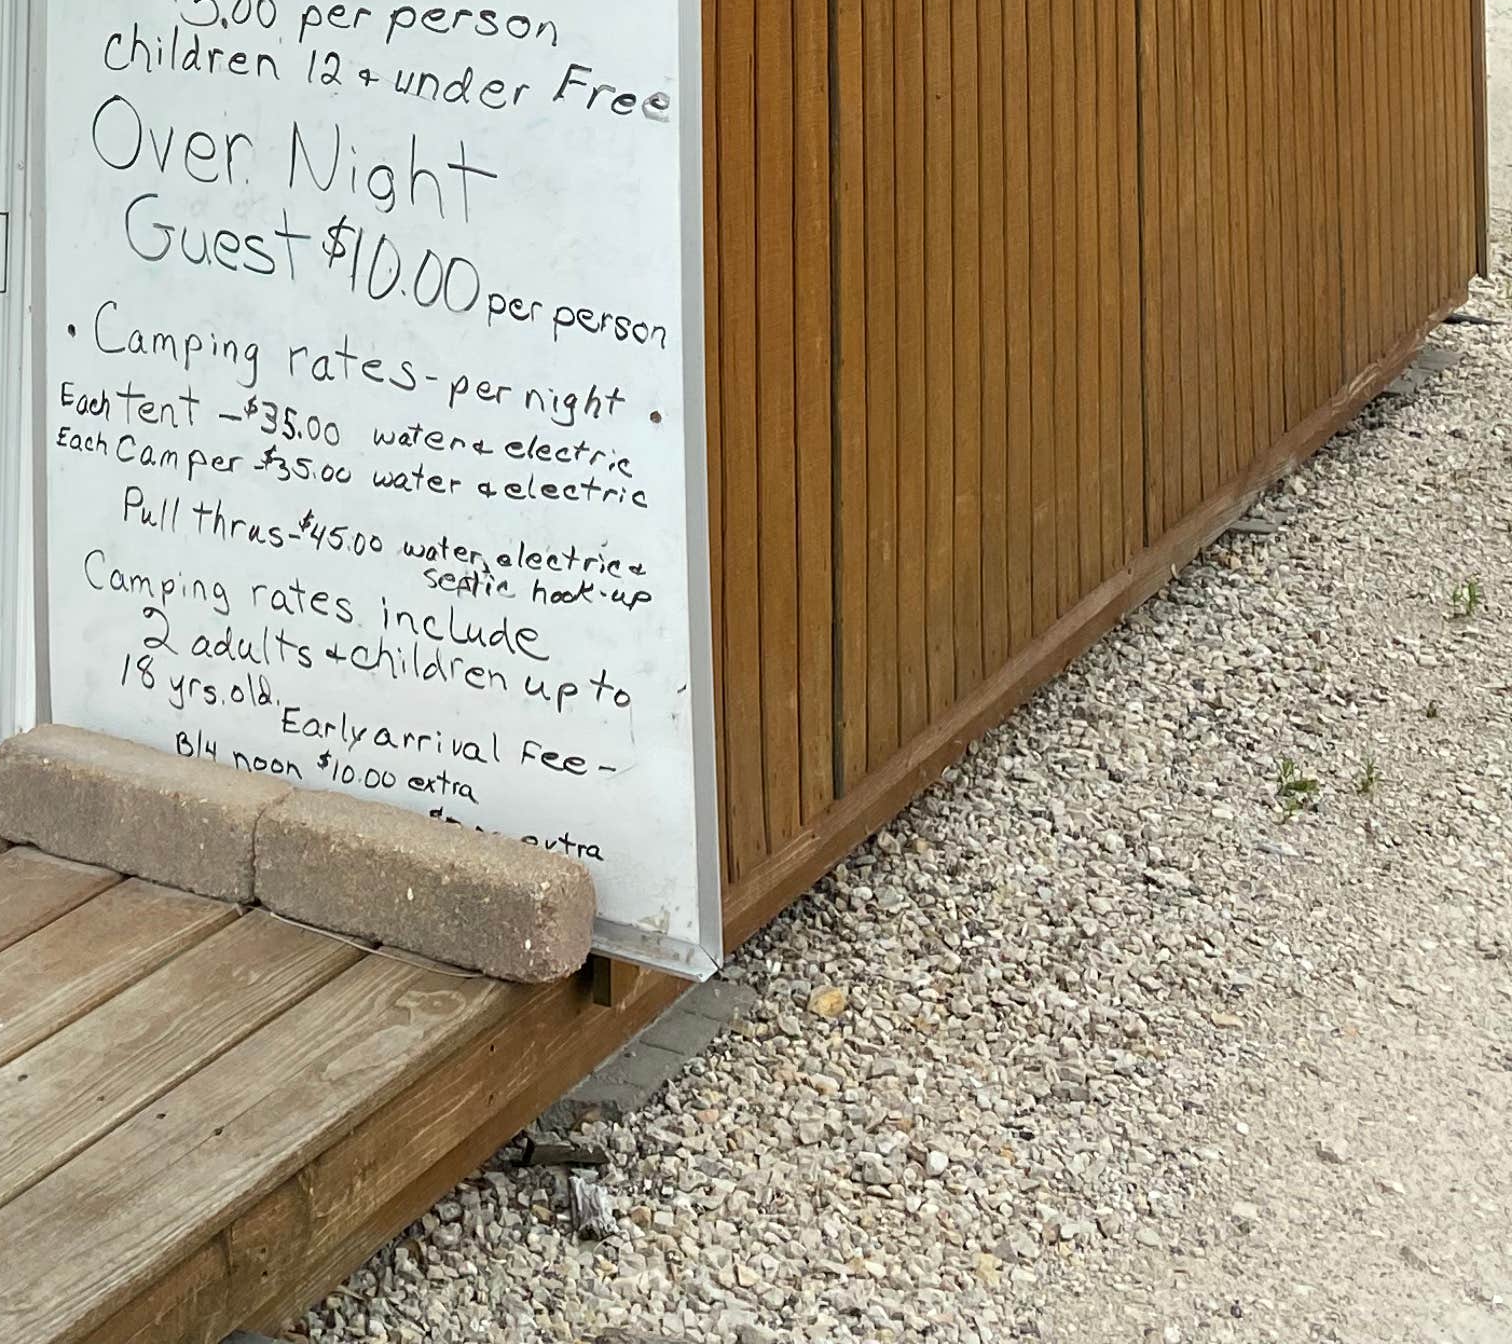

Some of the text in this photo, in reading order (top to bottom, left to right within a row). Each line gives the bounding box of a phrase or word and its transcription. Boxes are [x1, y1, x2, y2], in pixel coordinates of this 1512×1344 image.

[102, 23, 281, 80] children
[307, 49, 342, 86] 12
[394, 66, 531, 109] under
[552, 63, 672, 123] Free
[299, 5, 372, 43] per
[385, 4, 559, 47] person
[91, 93, 498, 224] Over Night
[125, 192, 667, 350] Guest $10.00 per person
[94, 300, 260, 389] Camping
[524, 384, 626, 427] night
[55, 426, 108, 456] Each
[372, 462, 463, 494] water
[503, 472, 649, 509] electric
[60, 381, 110, 422] Each
[115, 380, 201, 429] tent
[504, 434, 634, 479] electric
[123, 485, 180, 533] Pull
[495, 540, 628, 579] electric
[84, 548, 551, 661] Camping rates include
[121, 652, 156, 689] 18
[280, 706, 368, 753] Early
[373, 726, 501, 764] arrival
[141, 605, 179, 656] 2
[190, 625, 313, 669] adults
[349, 635, 508, 691] children
[524, 674, 579, 714] up
[589, 668, 632, 708] to
[232, 750, 304, 780] noon
[316, 749, 397, 789] $10.00
[407, 769, 481, 806] extra
